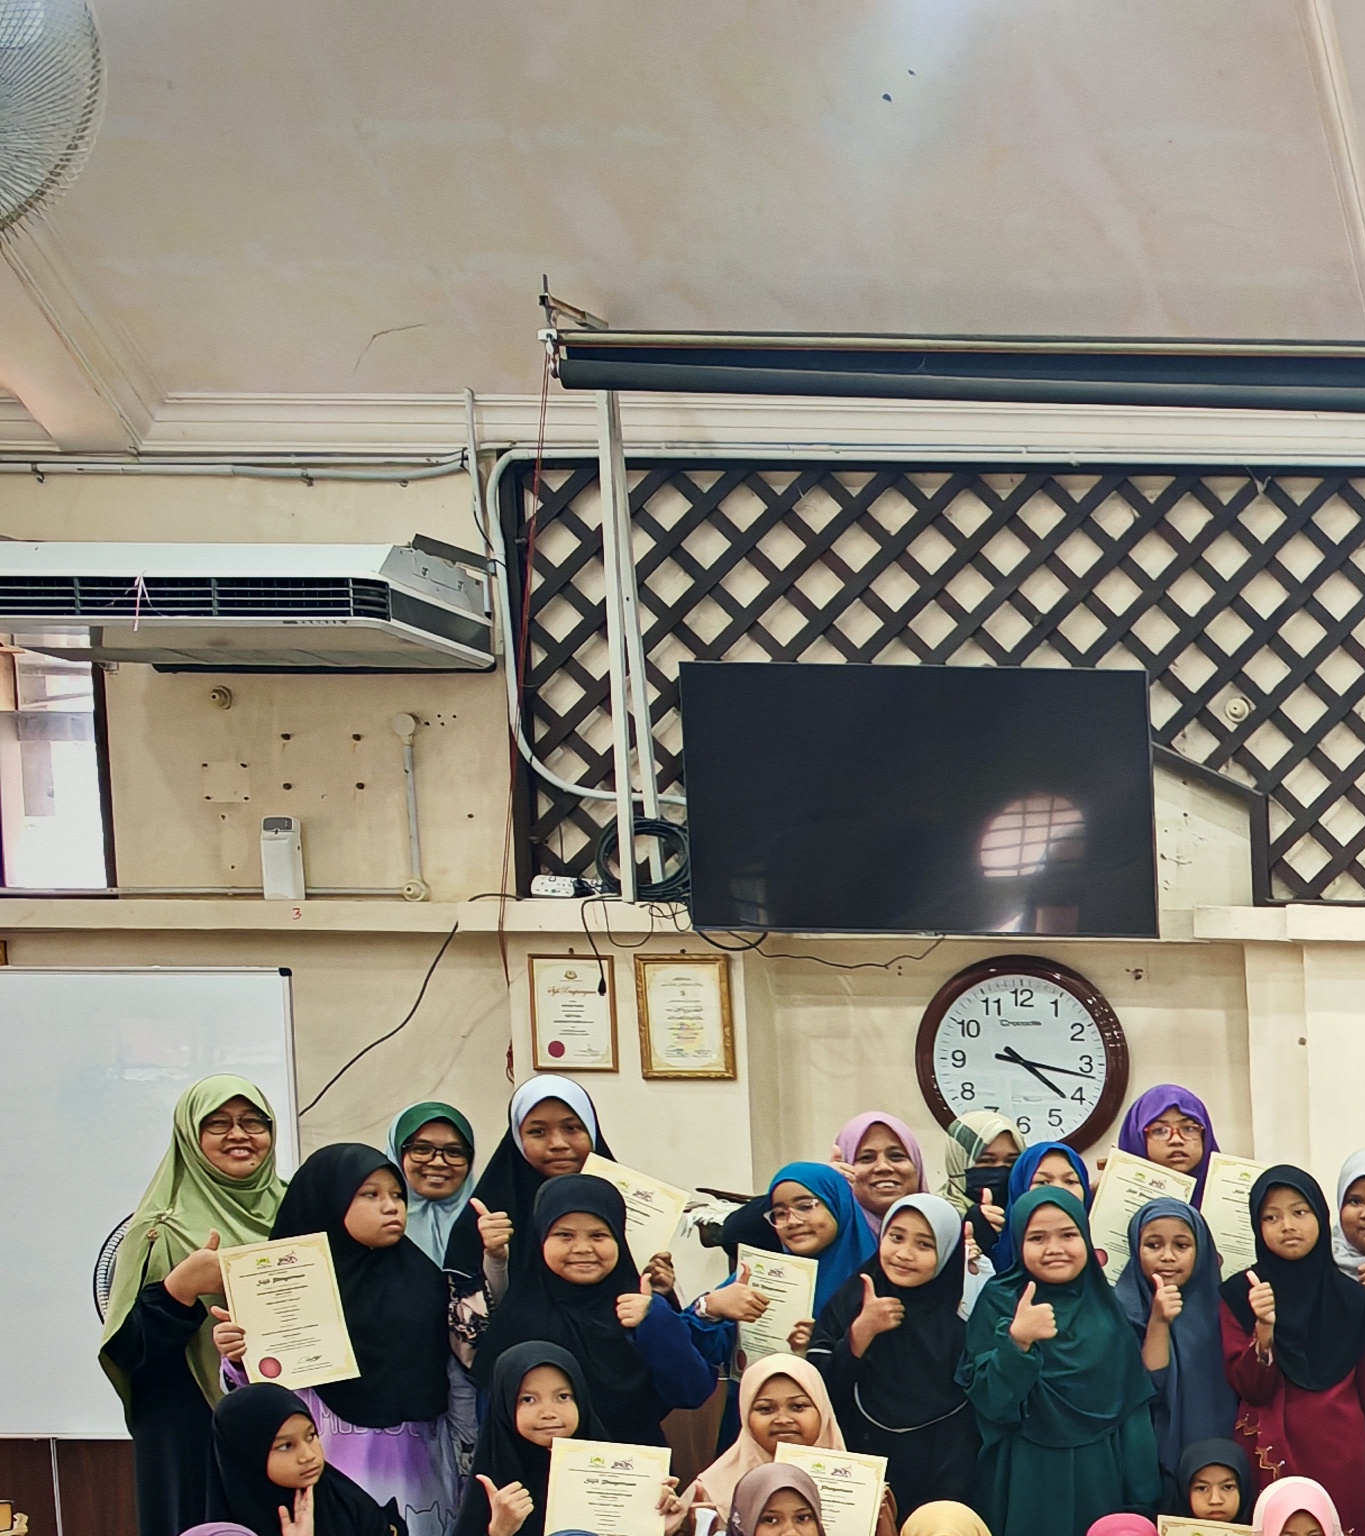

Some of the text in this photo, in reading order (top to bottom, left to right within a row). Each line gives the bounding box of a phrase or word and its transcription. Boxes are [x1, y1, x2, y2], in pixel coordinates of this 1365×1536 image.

[292, 907, 302, 920] 3
[981, 997, 1001, 1016] 11
[1010, 988, 1034, 1007] 12
[1050, 999, 1059, 1018] 1
[957, 1019, 980, 1038] 10
[1070, 1023, 1085, 1042] 2
[951, 1050, 967, 1068] 9
[1079, 1055, 1093, 1073] 3
[960, 1082, 975, 1100] 8
[1071, 1087, 1086, 1105] 4
[1016, 1116, 1031, 1134] 6
[1048, 1109, 1063, 1127] 5
